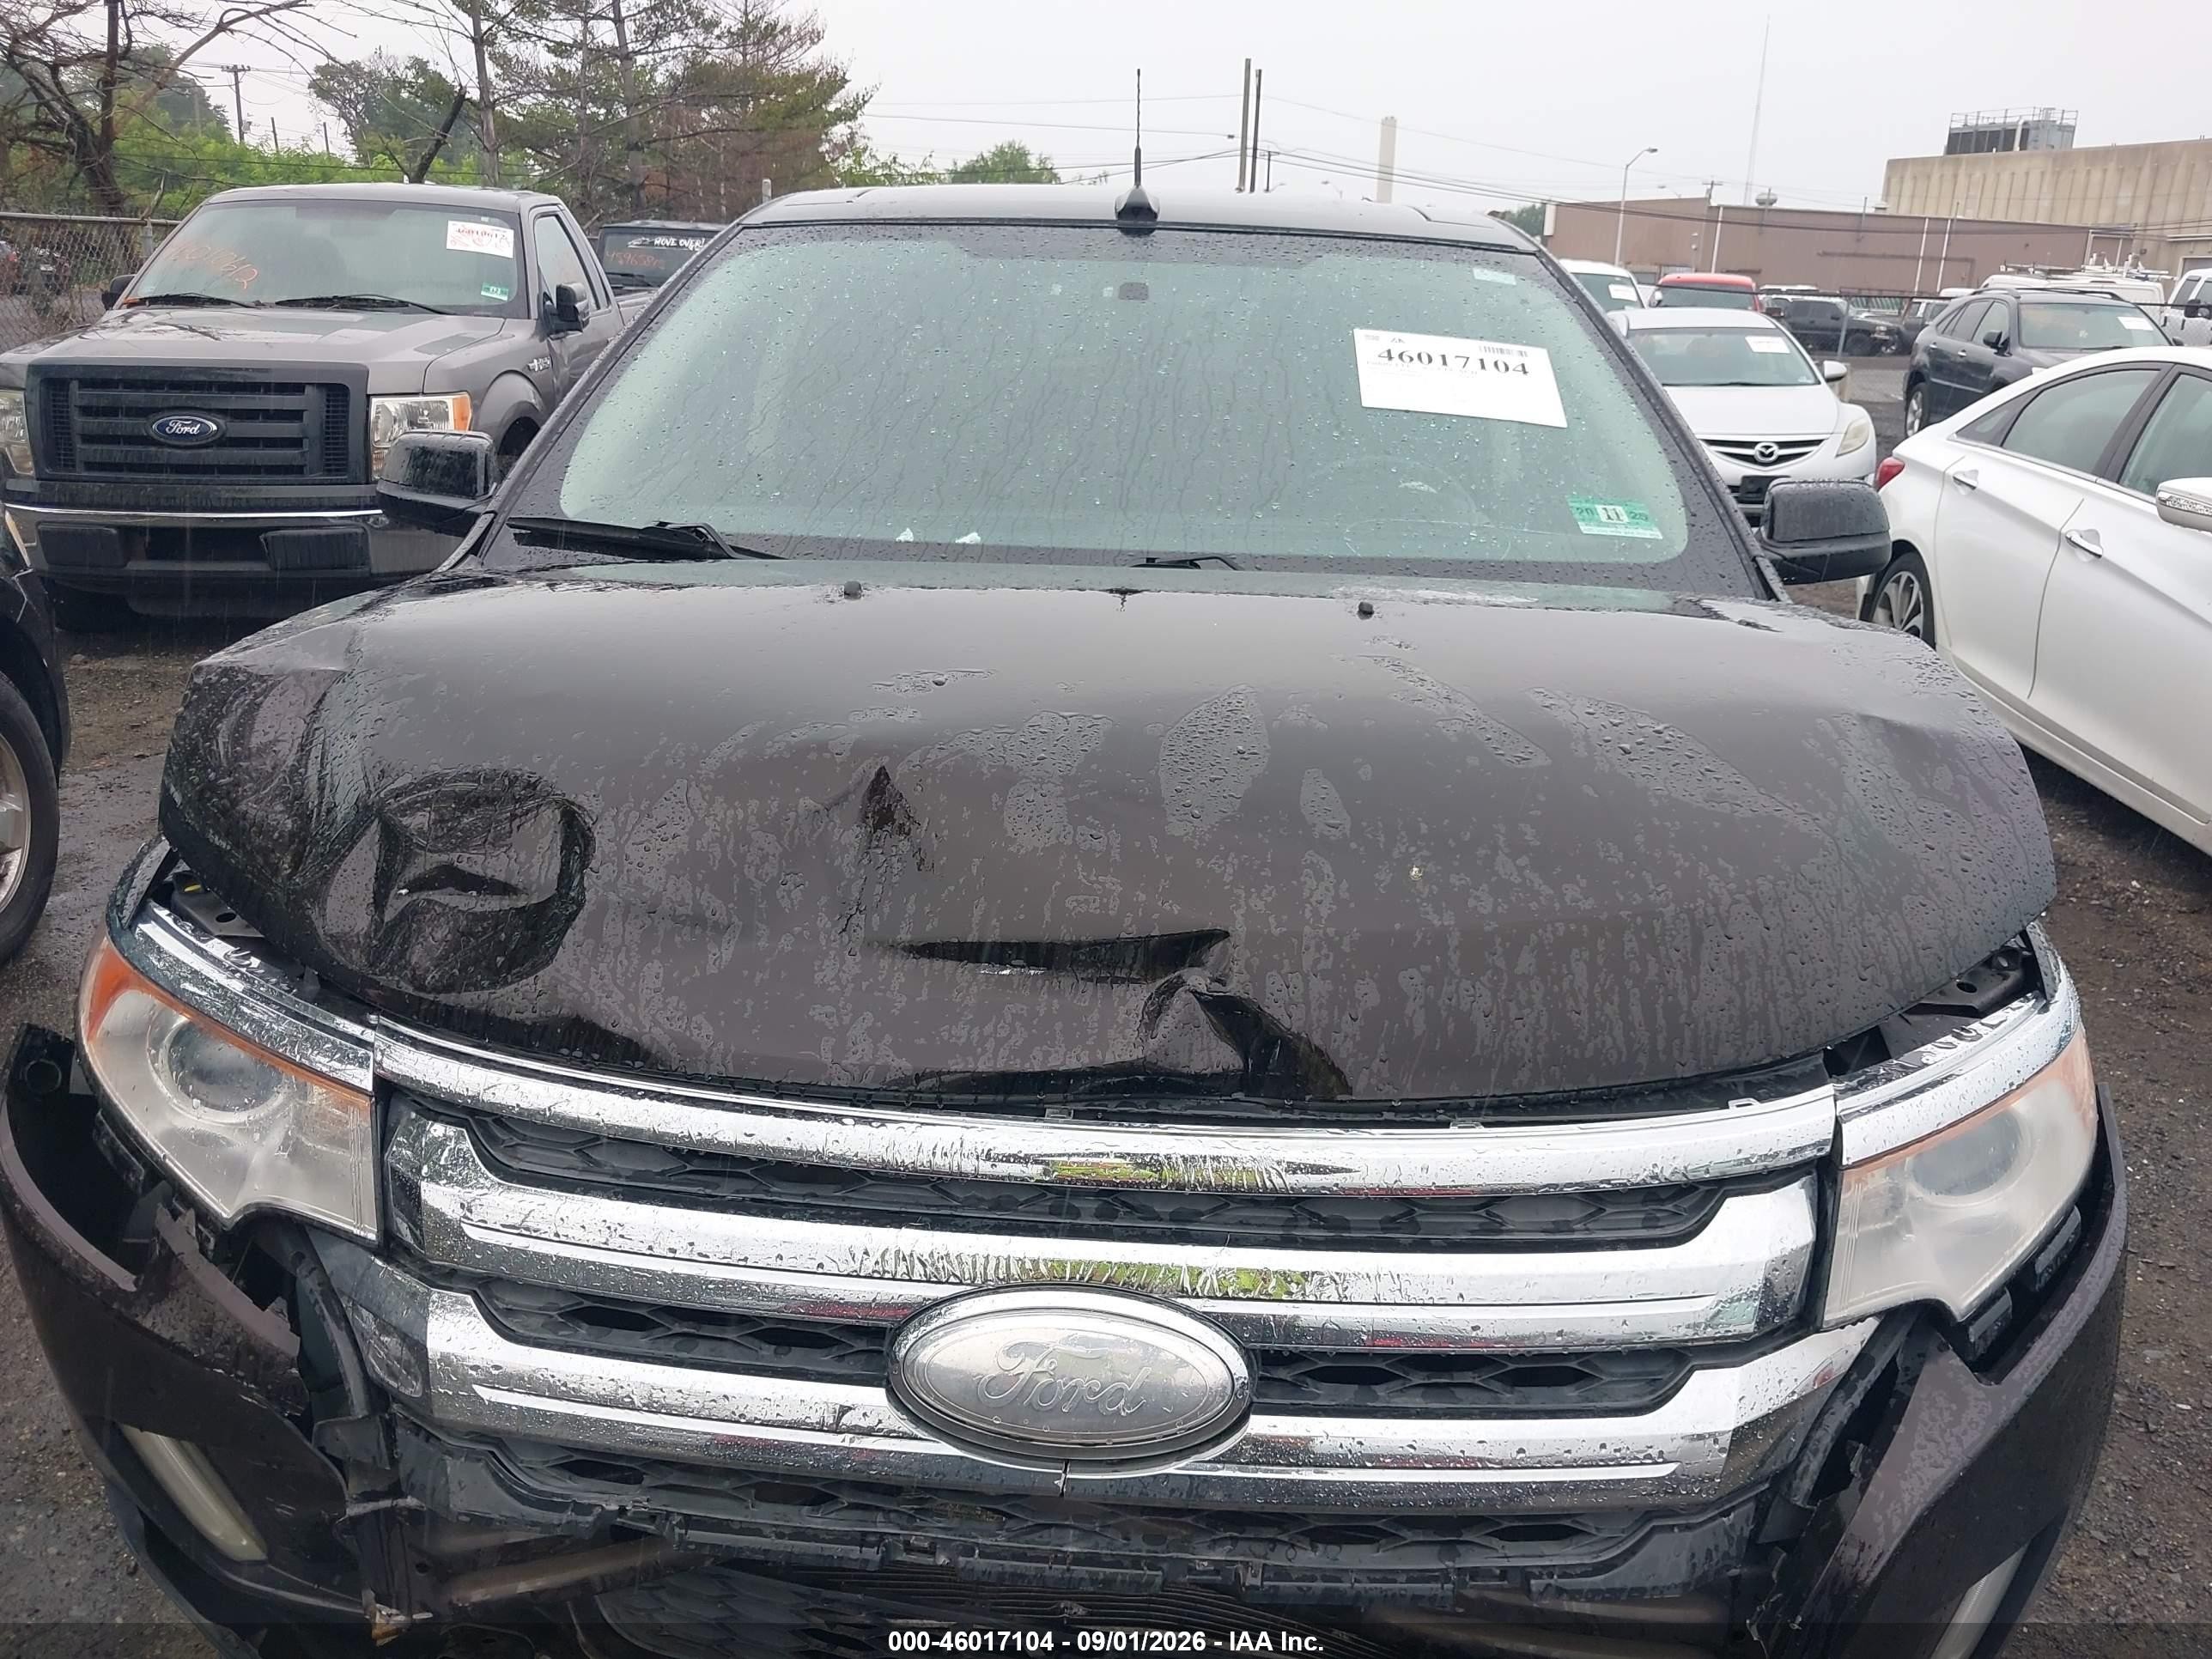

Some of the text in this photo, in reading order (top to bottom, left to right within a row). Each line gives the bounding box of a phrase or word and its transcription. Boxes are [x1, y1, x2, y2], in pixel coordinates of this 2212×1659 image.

[653, 237, 705, 251] MOVE OVER!
[1376, 348, 1529, 376] 46017104
[165, 419, 201, 434] Ford
[1601, 507, 1625, 522] 11
[976, 1339, 1152, 1416] Ford
